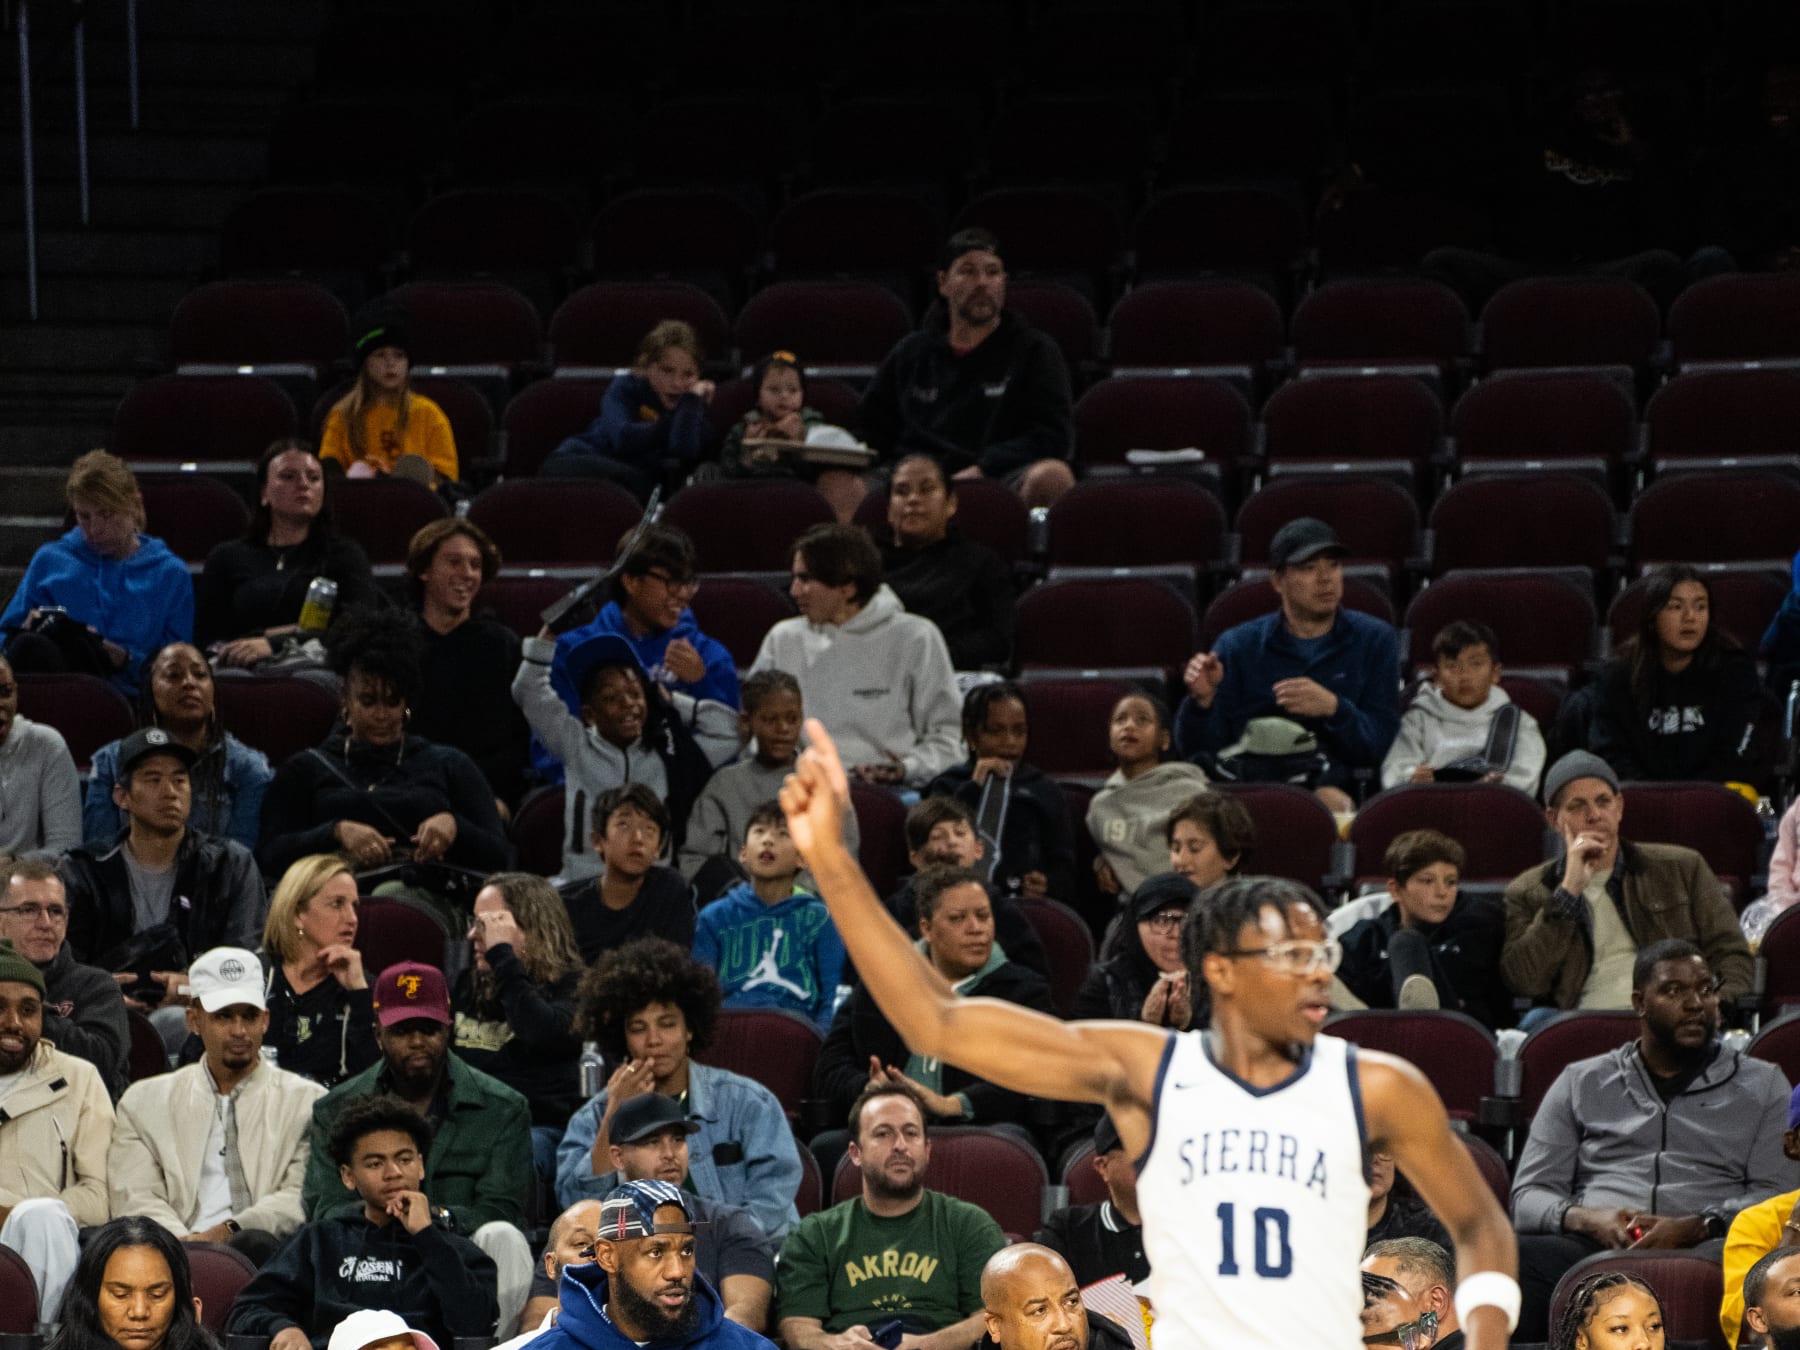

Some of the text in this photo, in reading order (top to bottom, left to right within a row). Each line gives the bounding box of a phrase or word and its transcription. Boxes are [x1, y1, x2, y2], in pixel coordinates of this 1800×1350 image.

[1179, 1129, 1328, 1200] SIERRA
[845, 1250, 938, 1288] AKRON
[1216, 1202, 1293, 1279] 10
